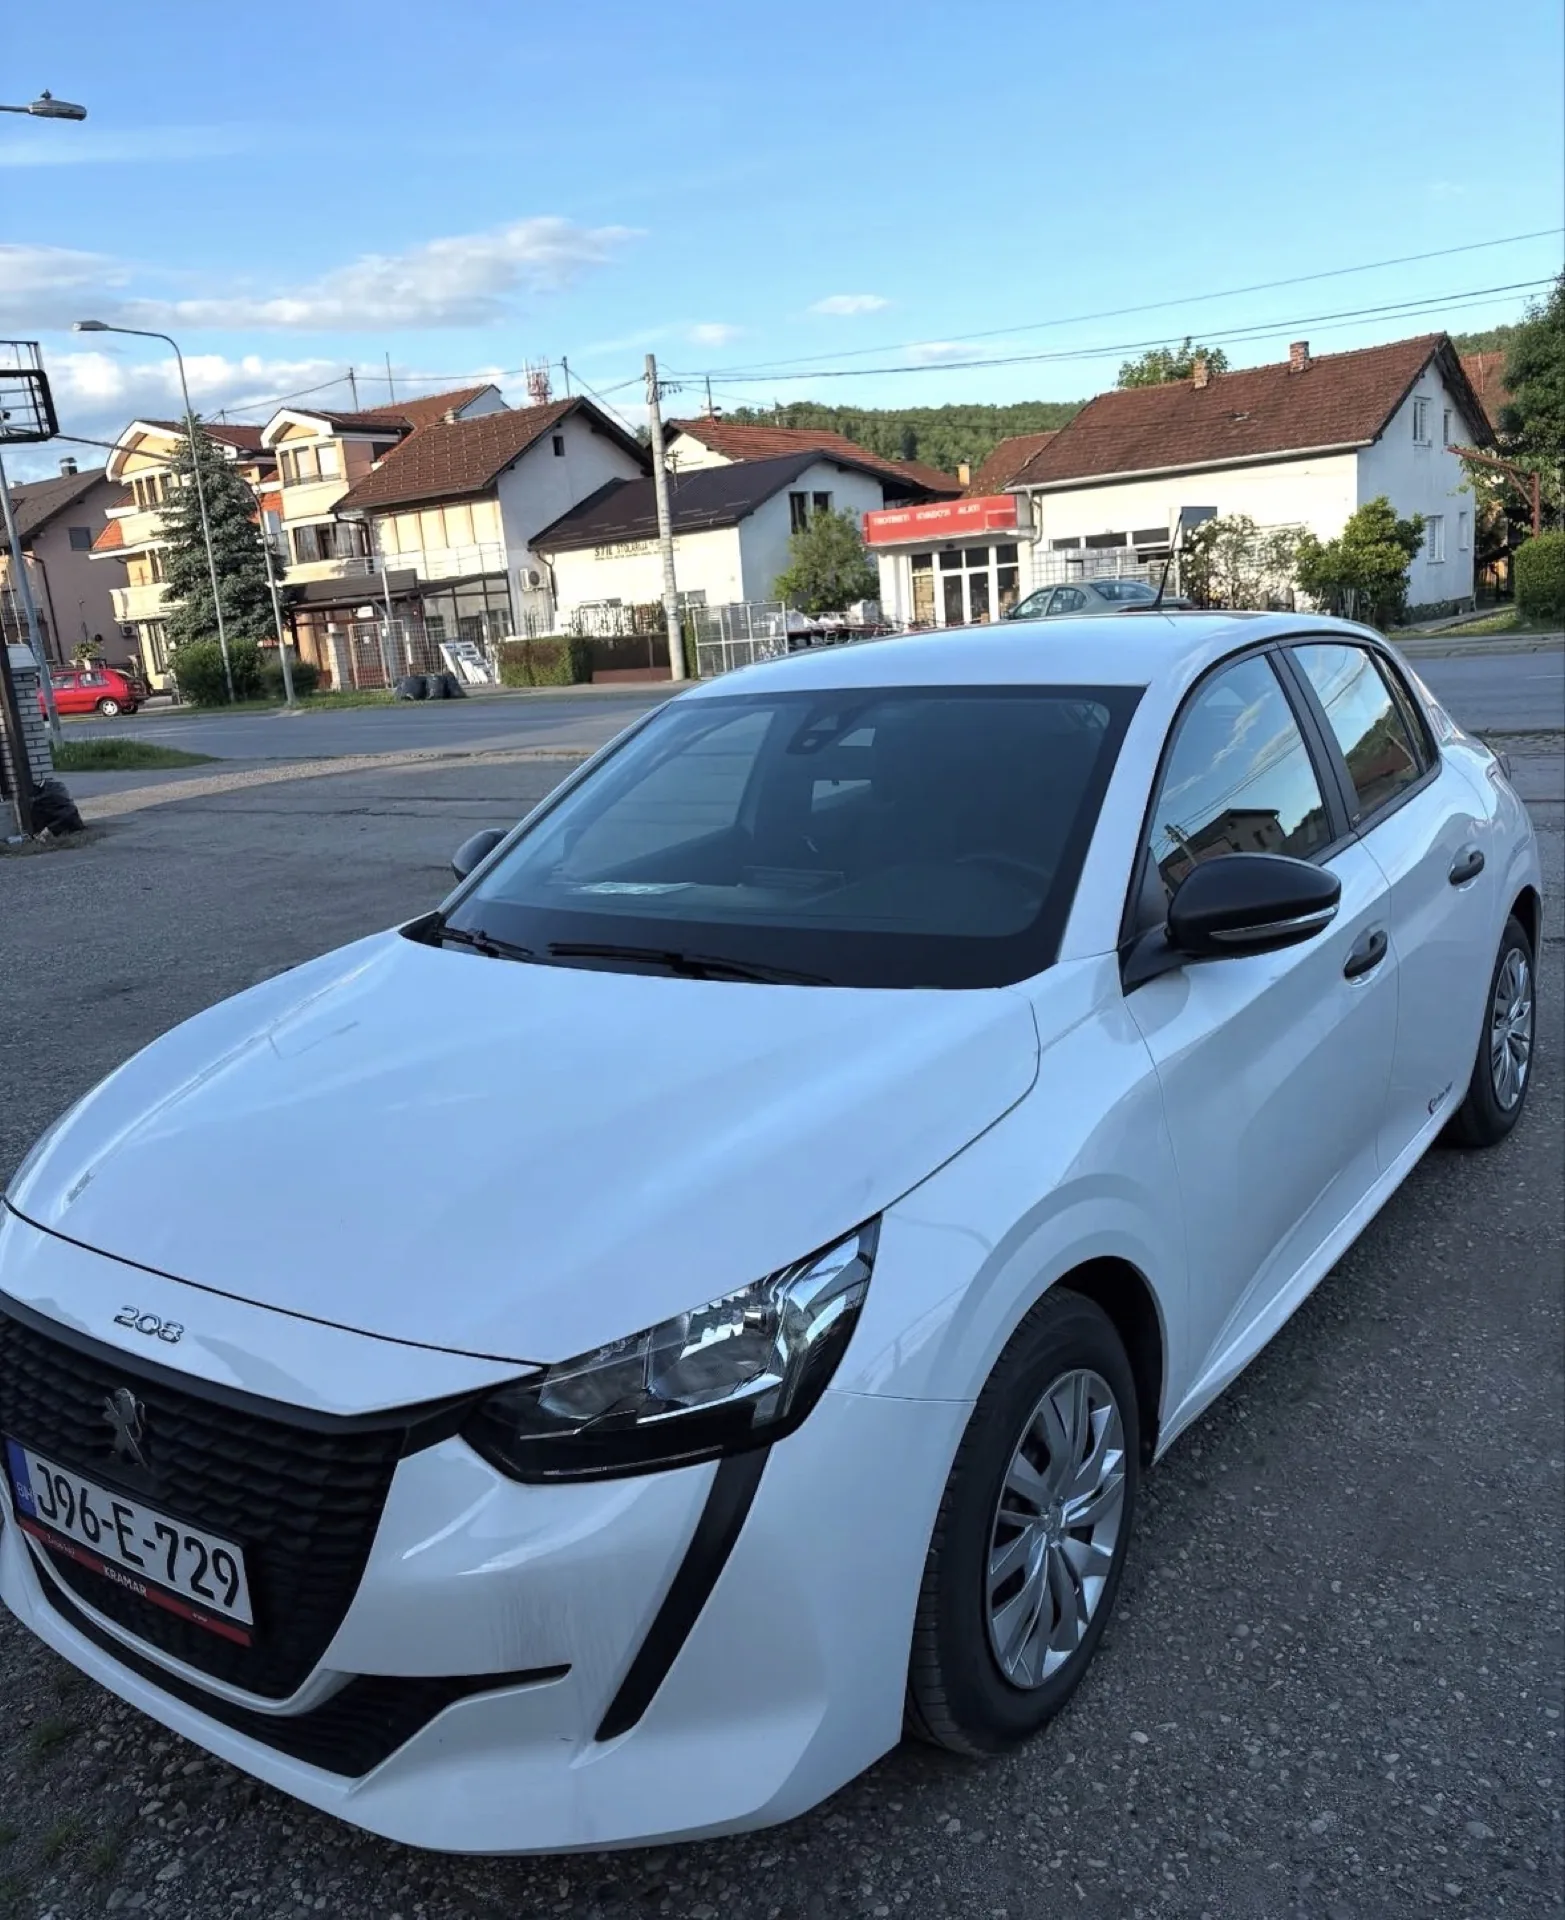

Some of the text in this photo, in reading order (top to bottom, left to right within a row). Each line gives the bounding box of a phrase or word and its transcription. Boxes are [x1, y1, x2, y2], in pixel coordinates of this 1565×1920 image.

[113, 1305, 185, 1344] 208
[36, 1462, 240, 1608] J96-E-729
[103, 1565, 148, 1597] KRAMAR
